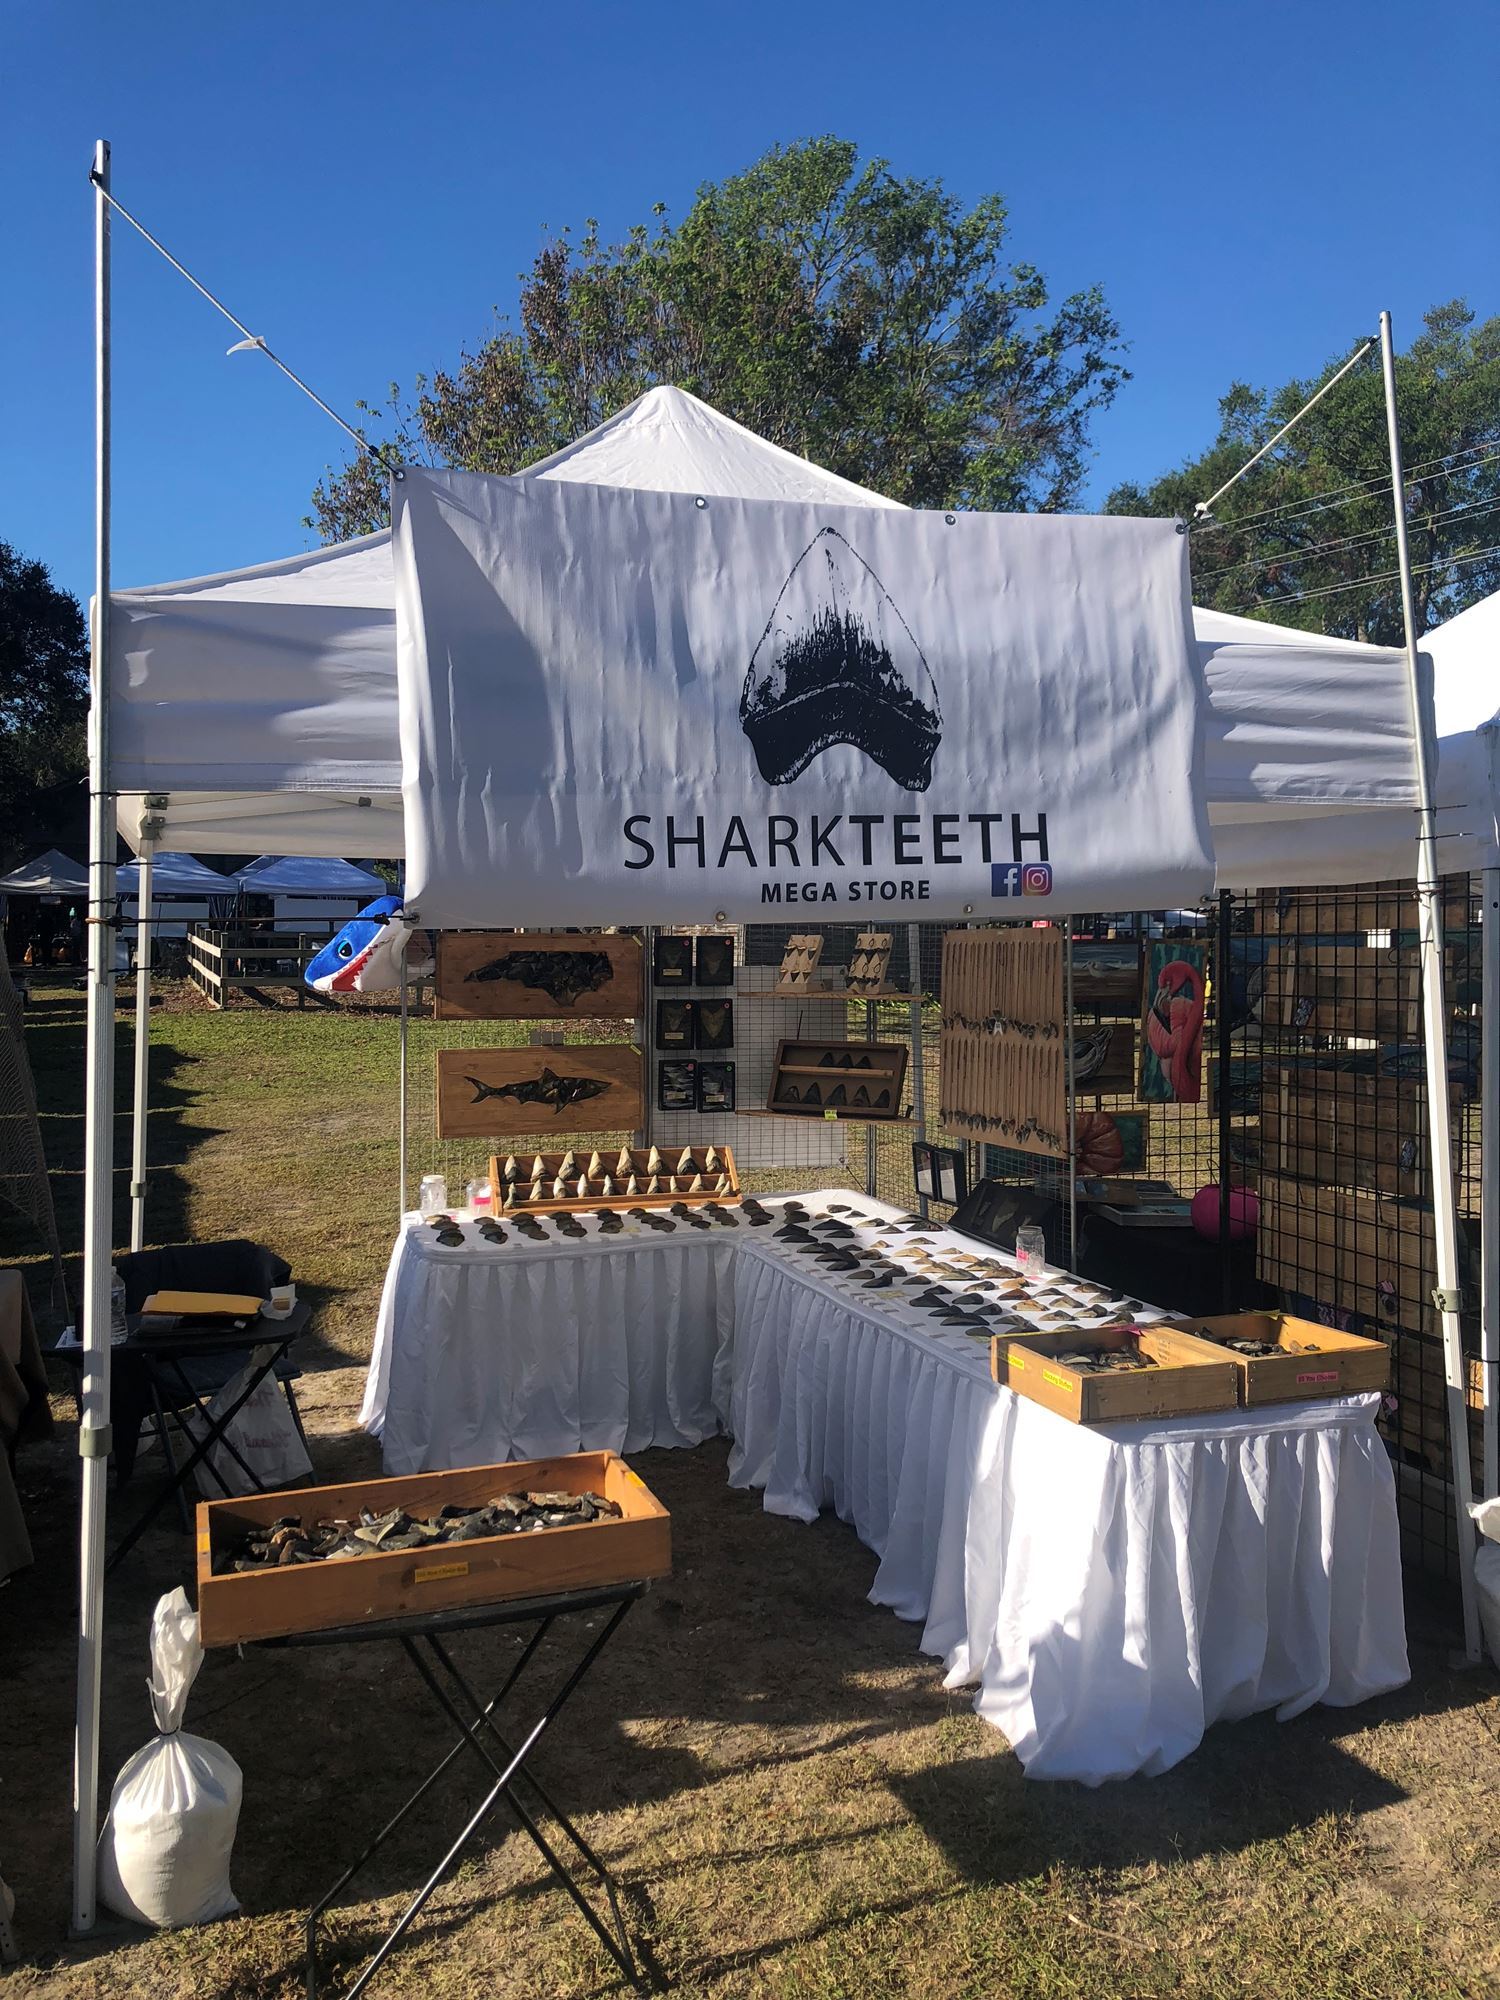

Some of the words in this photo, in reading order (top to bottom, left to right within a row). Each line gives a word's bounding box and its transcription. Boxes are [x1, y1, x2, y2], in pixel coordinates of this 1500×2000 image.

[623, 812, 1049, 870] SHARKTEETH
[760, 881, 838, 904] MEGA
[848, 879, 931, 902] STORE
